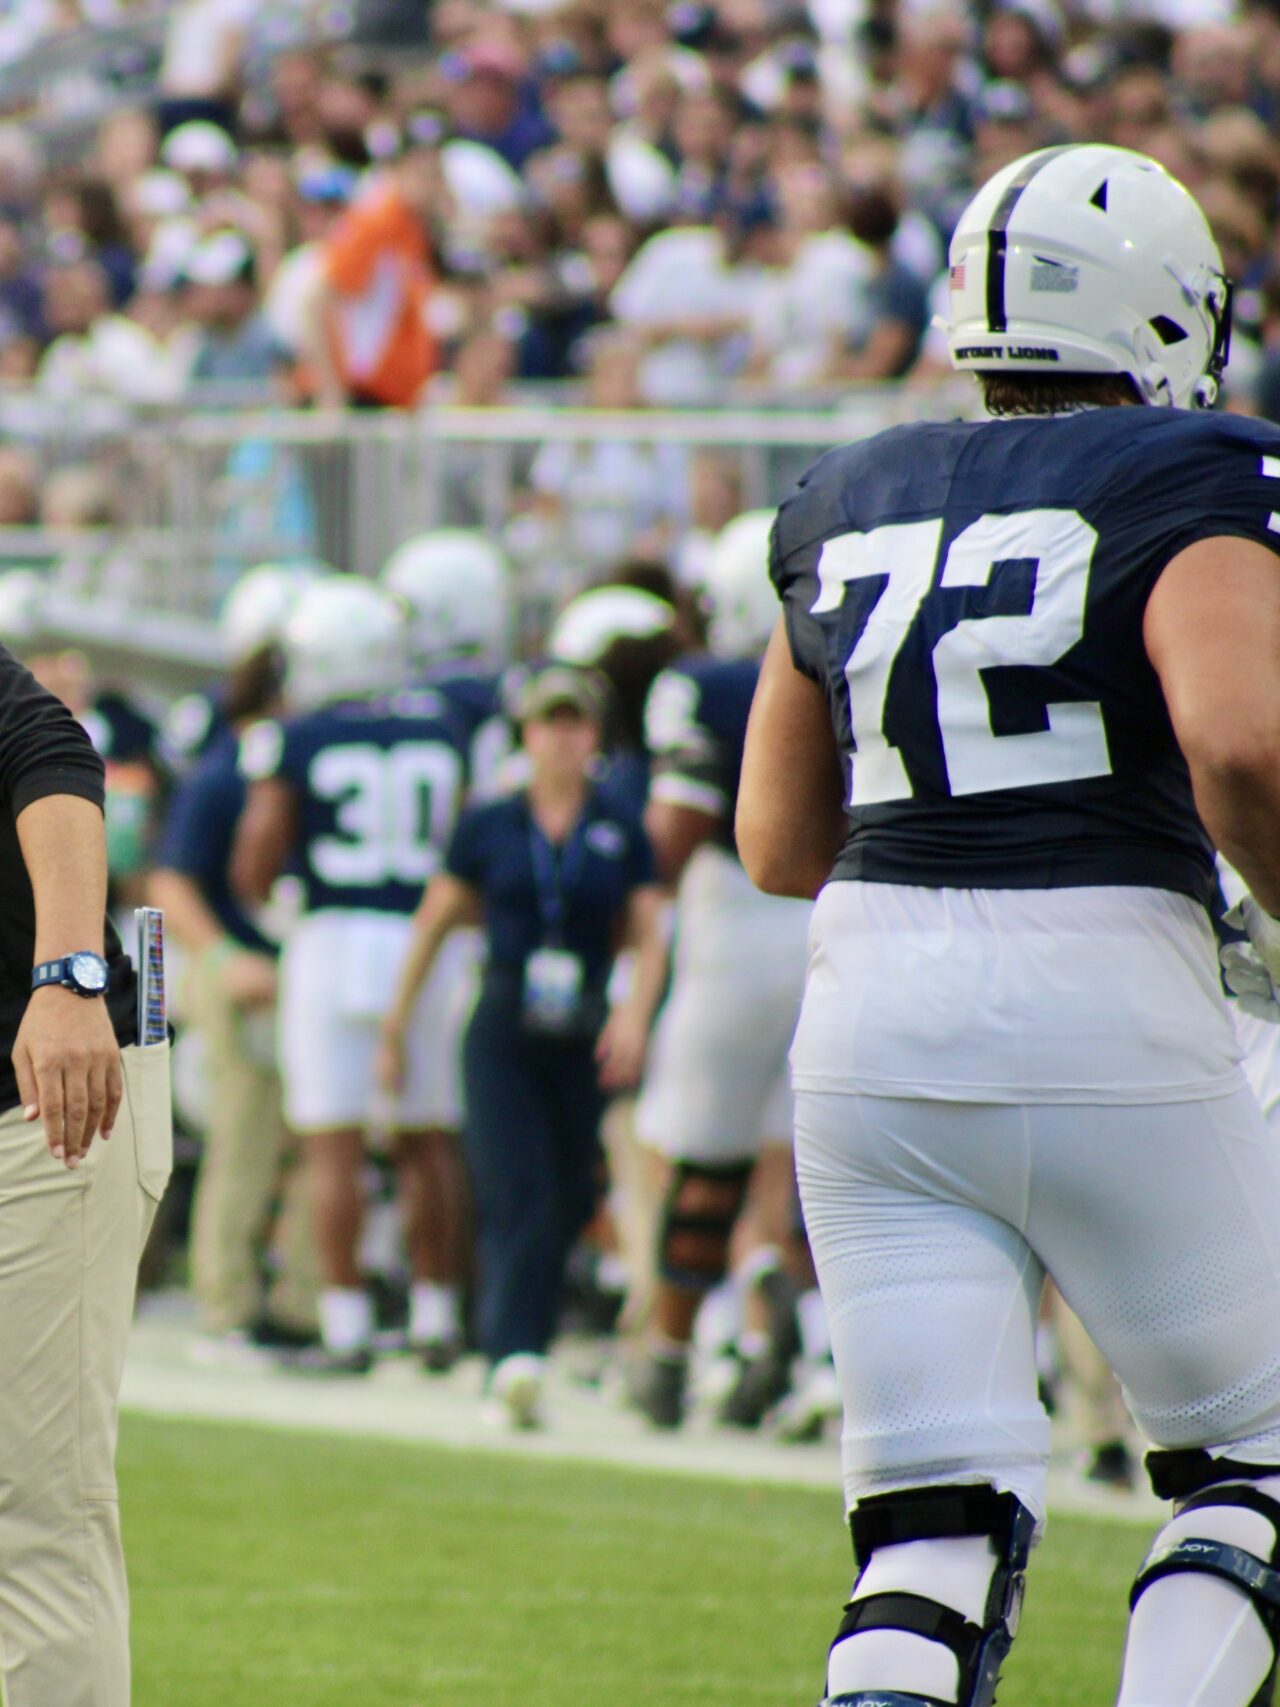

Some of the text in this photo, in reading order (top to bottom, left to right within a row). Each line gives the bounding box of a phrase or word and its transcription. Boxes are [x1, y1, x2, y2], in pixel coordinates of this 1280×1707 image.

[1007, 346, 1058, 361] LIONS
[809, 508, 1112, 806] 72
[309, 741, 461, 887] 30
